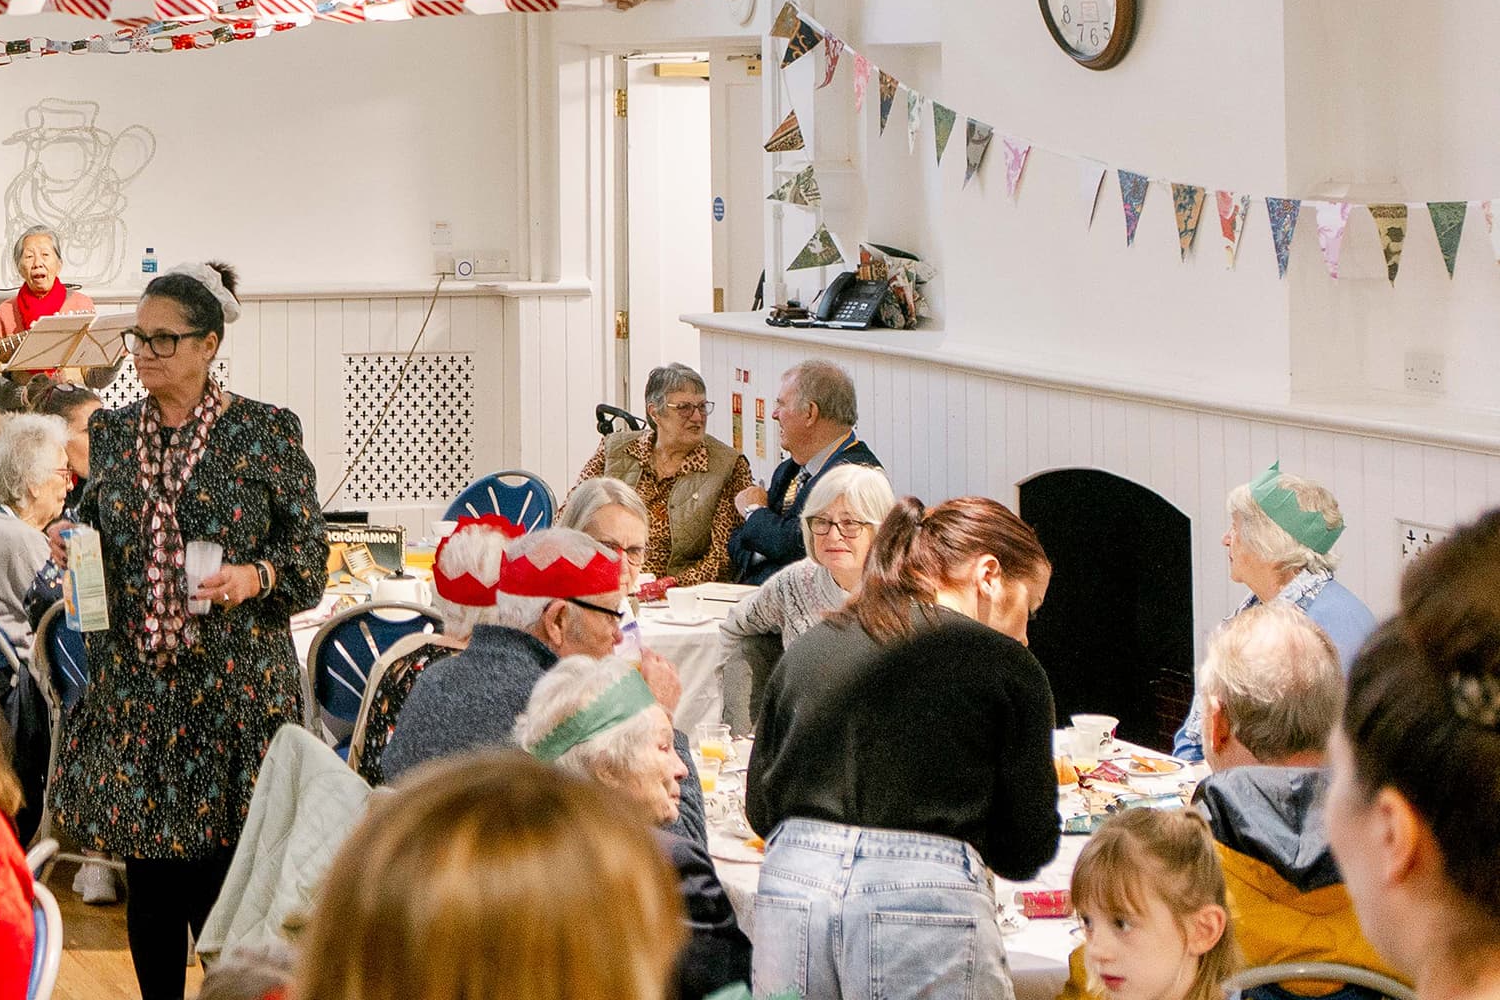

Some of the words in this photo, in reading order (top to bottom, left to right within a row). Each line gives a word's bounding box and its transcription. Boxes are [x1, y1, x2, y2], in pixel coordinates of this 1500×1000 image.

[1062, 4, 1071, 24] 8
[1076, 23, 1085, 42] 7
[1090, 27, 1099, 46] 6
[1103, 22, 1111, 41] 5
